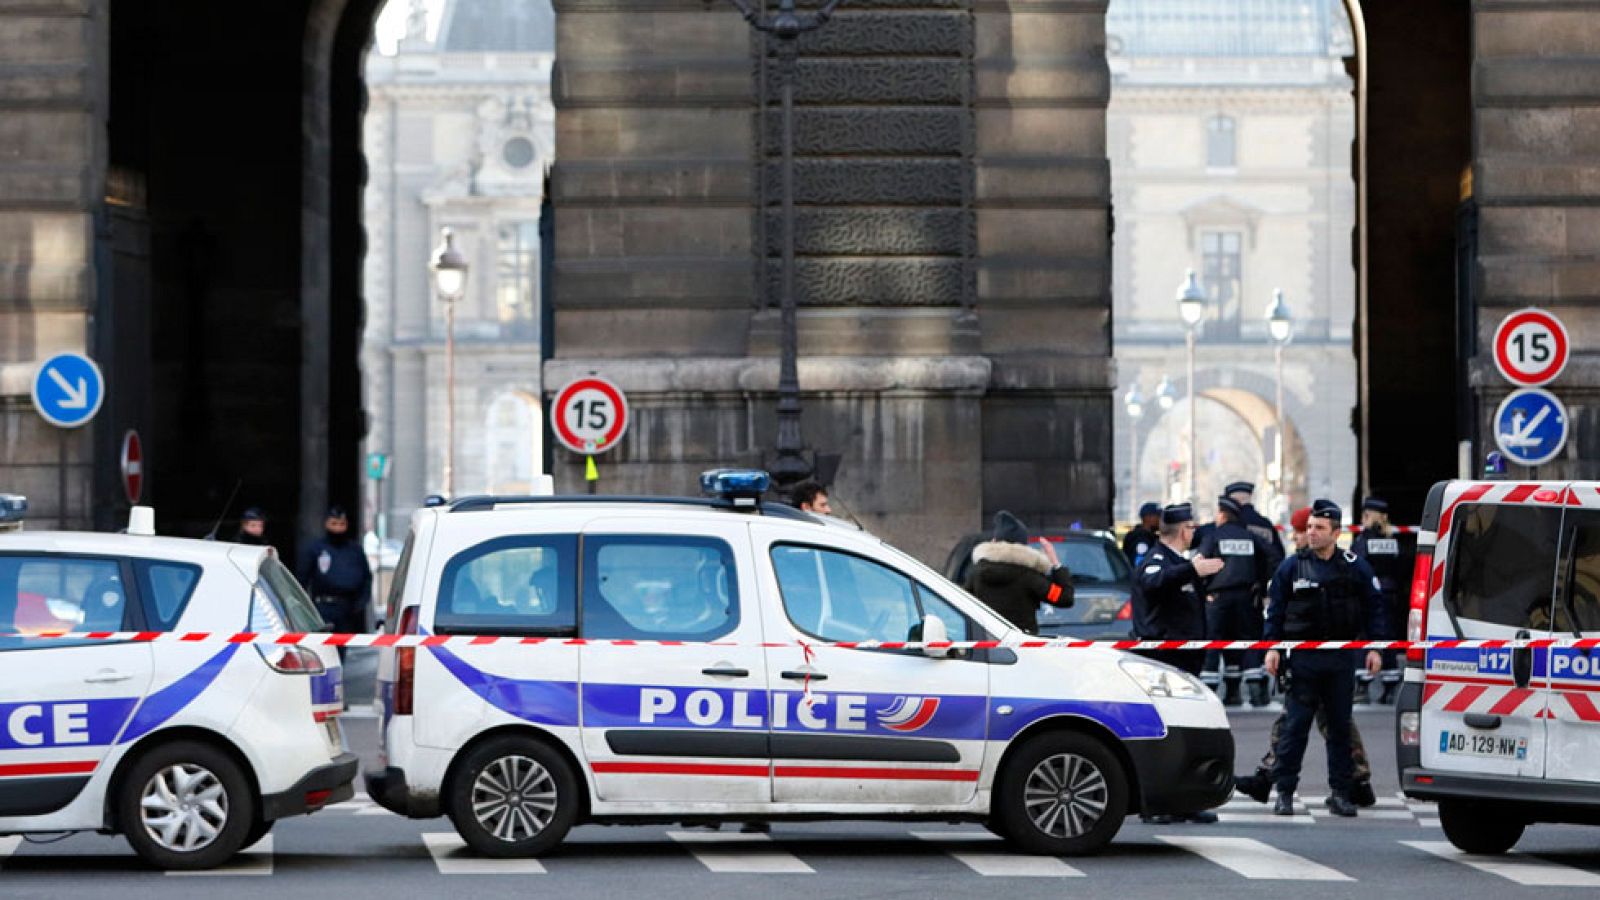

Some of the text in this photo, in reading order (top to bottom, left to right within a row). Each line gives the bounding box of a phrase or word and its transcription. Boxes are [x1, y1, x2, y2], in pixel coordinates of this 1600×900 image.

[1512, 333, 1550, 362] 15
[573, 400, 607, 430] 15
[8, 703, 89, 745] CE
[639, 688, 868, 730] POLICE
[1449, 734, 1516, 755] AD-129-NW
